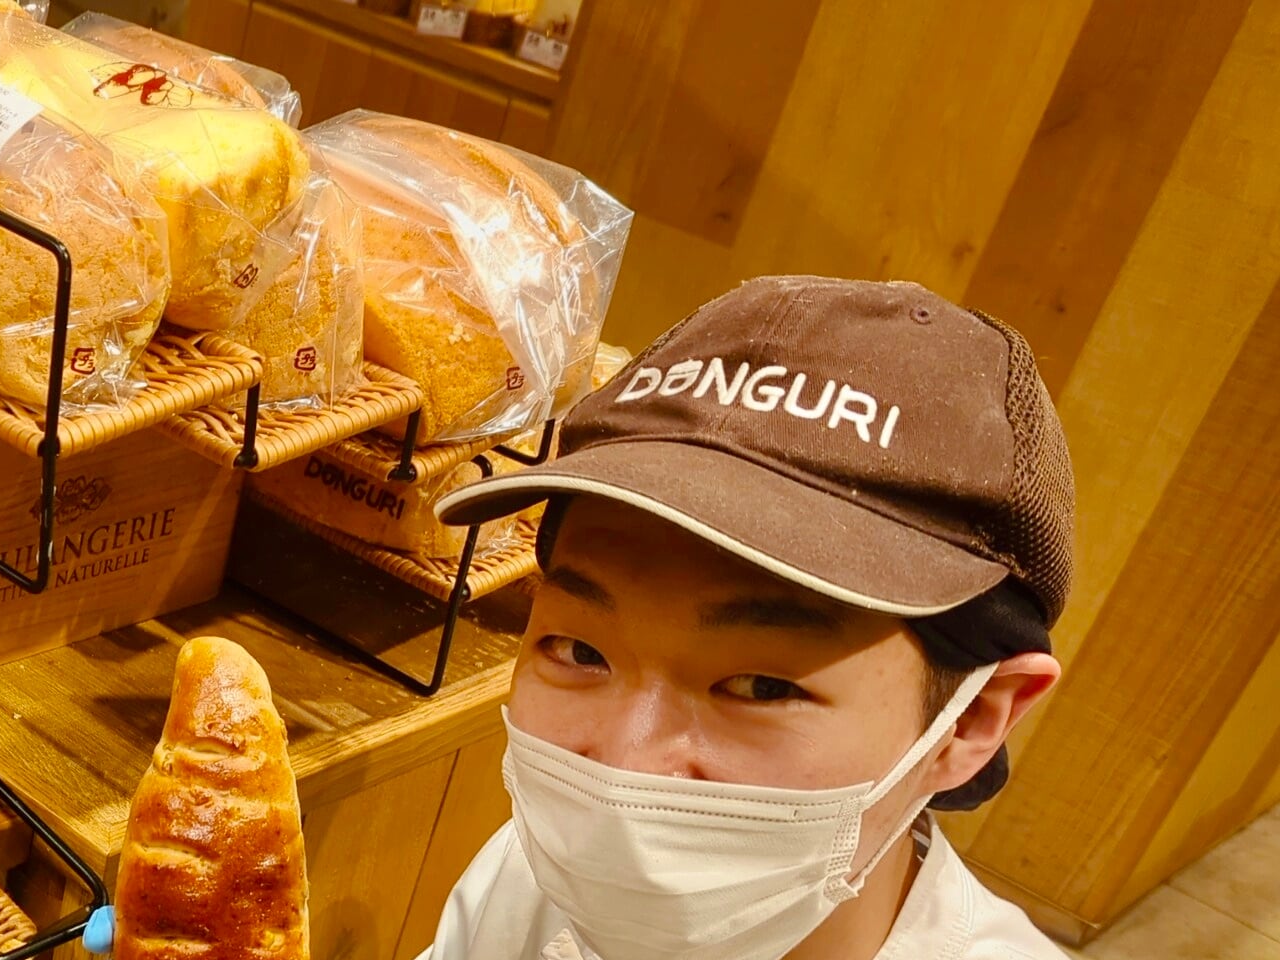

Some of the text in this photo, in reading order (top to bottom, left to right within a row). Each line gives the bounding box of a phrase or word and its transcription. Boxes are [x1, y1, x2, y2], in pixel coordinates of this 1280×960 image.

[615, 357, 900, 449] DONGURI
[304, 455, 405, 520] DONGURI
[54, 548, 150, 589] NATURELLE
